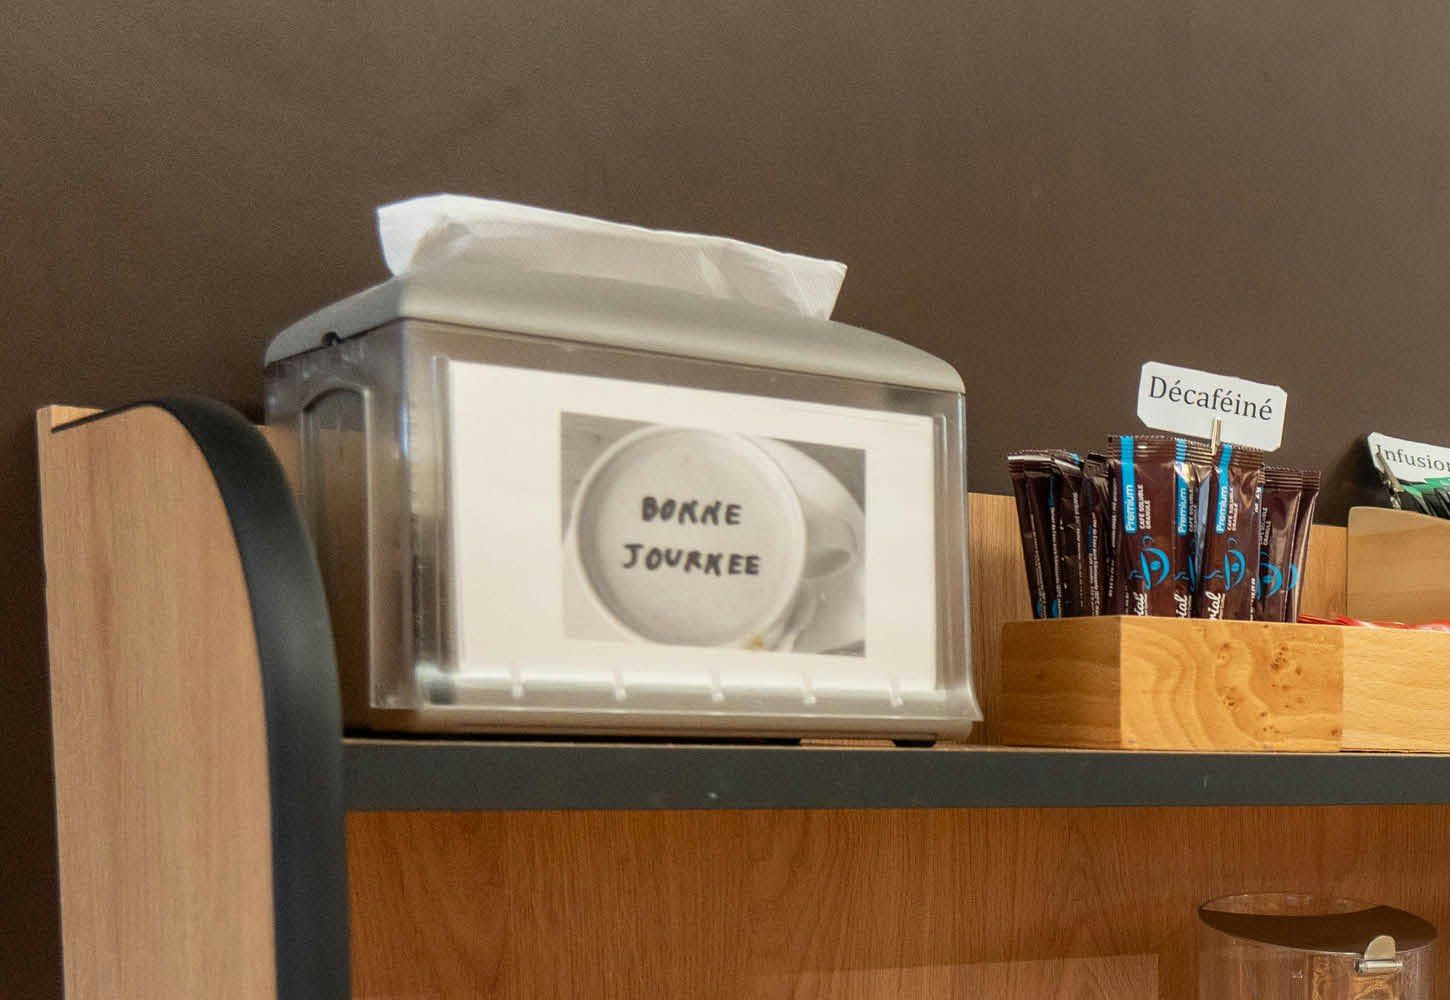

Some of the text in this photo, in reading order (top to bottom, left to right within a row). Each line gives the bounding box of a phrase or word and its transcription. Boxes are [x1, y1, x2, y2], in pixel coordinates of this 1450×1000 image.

[1148, 375, 1273, 421] Décaféiné
[641, 495, 743, 526] BONNE
[1125, 484, 1136, 532] Premium
[1178, 488, 1187, 533] Premium
[1216, 486, 1227, 532] Premium
[622, 543, 762, 577] JOURNEE
